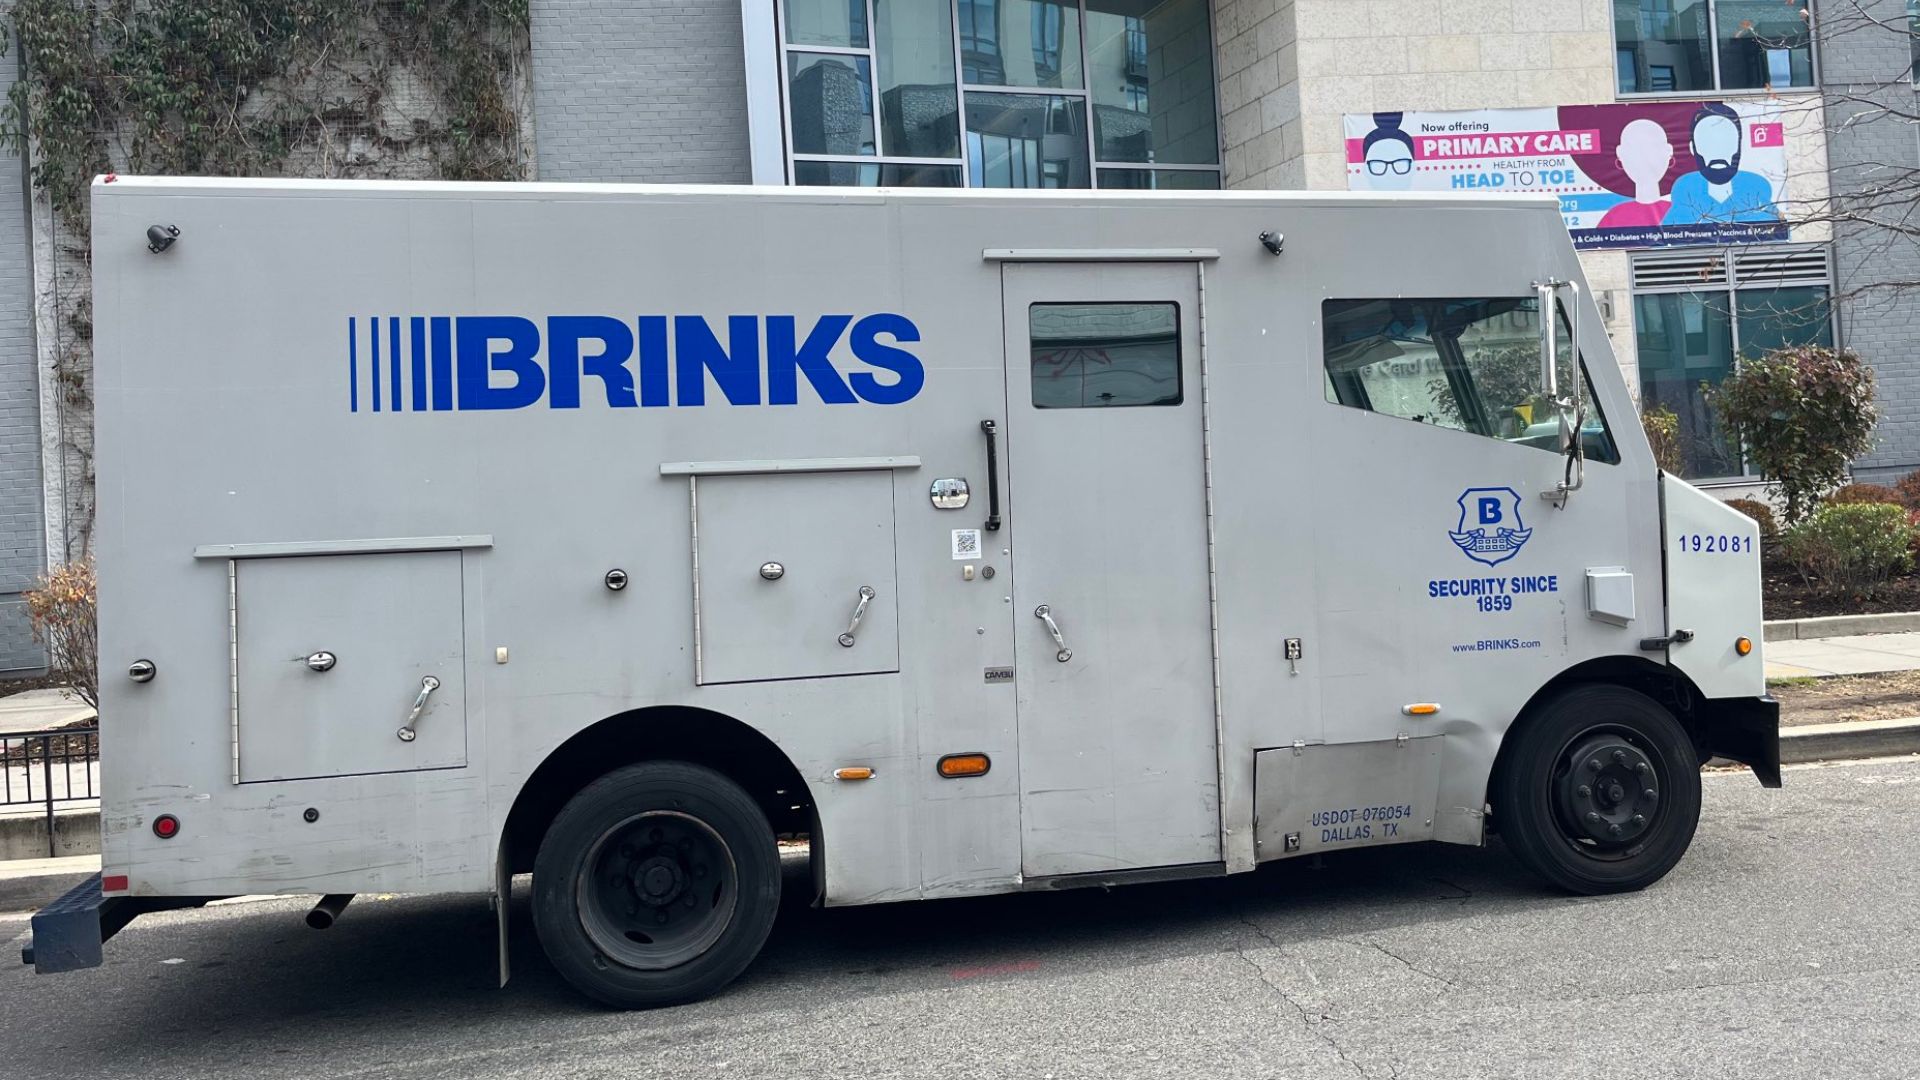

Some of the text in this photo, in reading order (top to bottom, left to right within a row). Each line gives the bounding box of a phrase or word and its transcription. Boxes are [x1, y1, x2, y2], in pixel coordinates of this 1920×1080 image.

[1421, 121, 1489, 132] Now offering
[1423, 133, 1593, 156] PRIMARY CARE
[1493, 159, 1566, 169] HEALTHY FROM
[1451, 169, 1575, 189] HEAD TO TOE
[1609, 233, 1640, 241] Diabetes
[456, 313, 924, 411] BRINKS
[1478, 497, 1502, 525] B
[1679, 534, 1751, 553] 192081
[1428, 575, 1558, 598] SECURITY SINCE
[1476, 595, 1512, 612] 1859
[1452, 638, 1541, 652] www.BRINKS.com
[1312, 805, 1411, 827] USDOT 076054
[1321, 823, 1398, 843] DALLAS, TX
